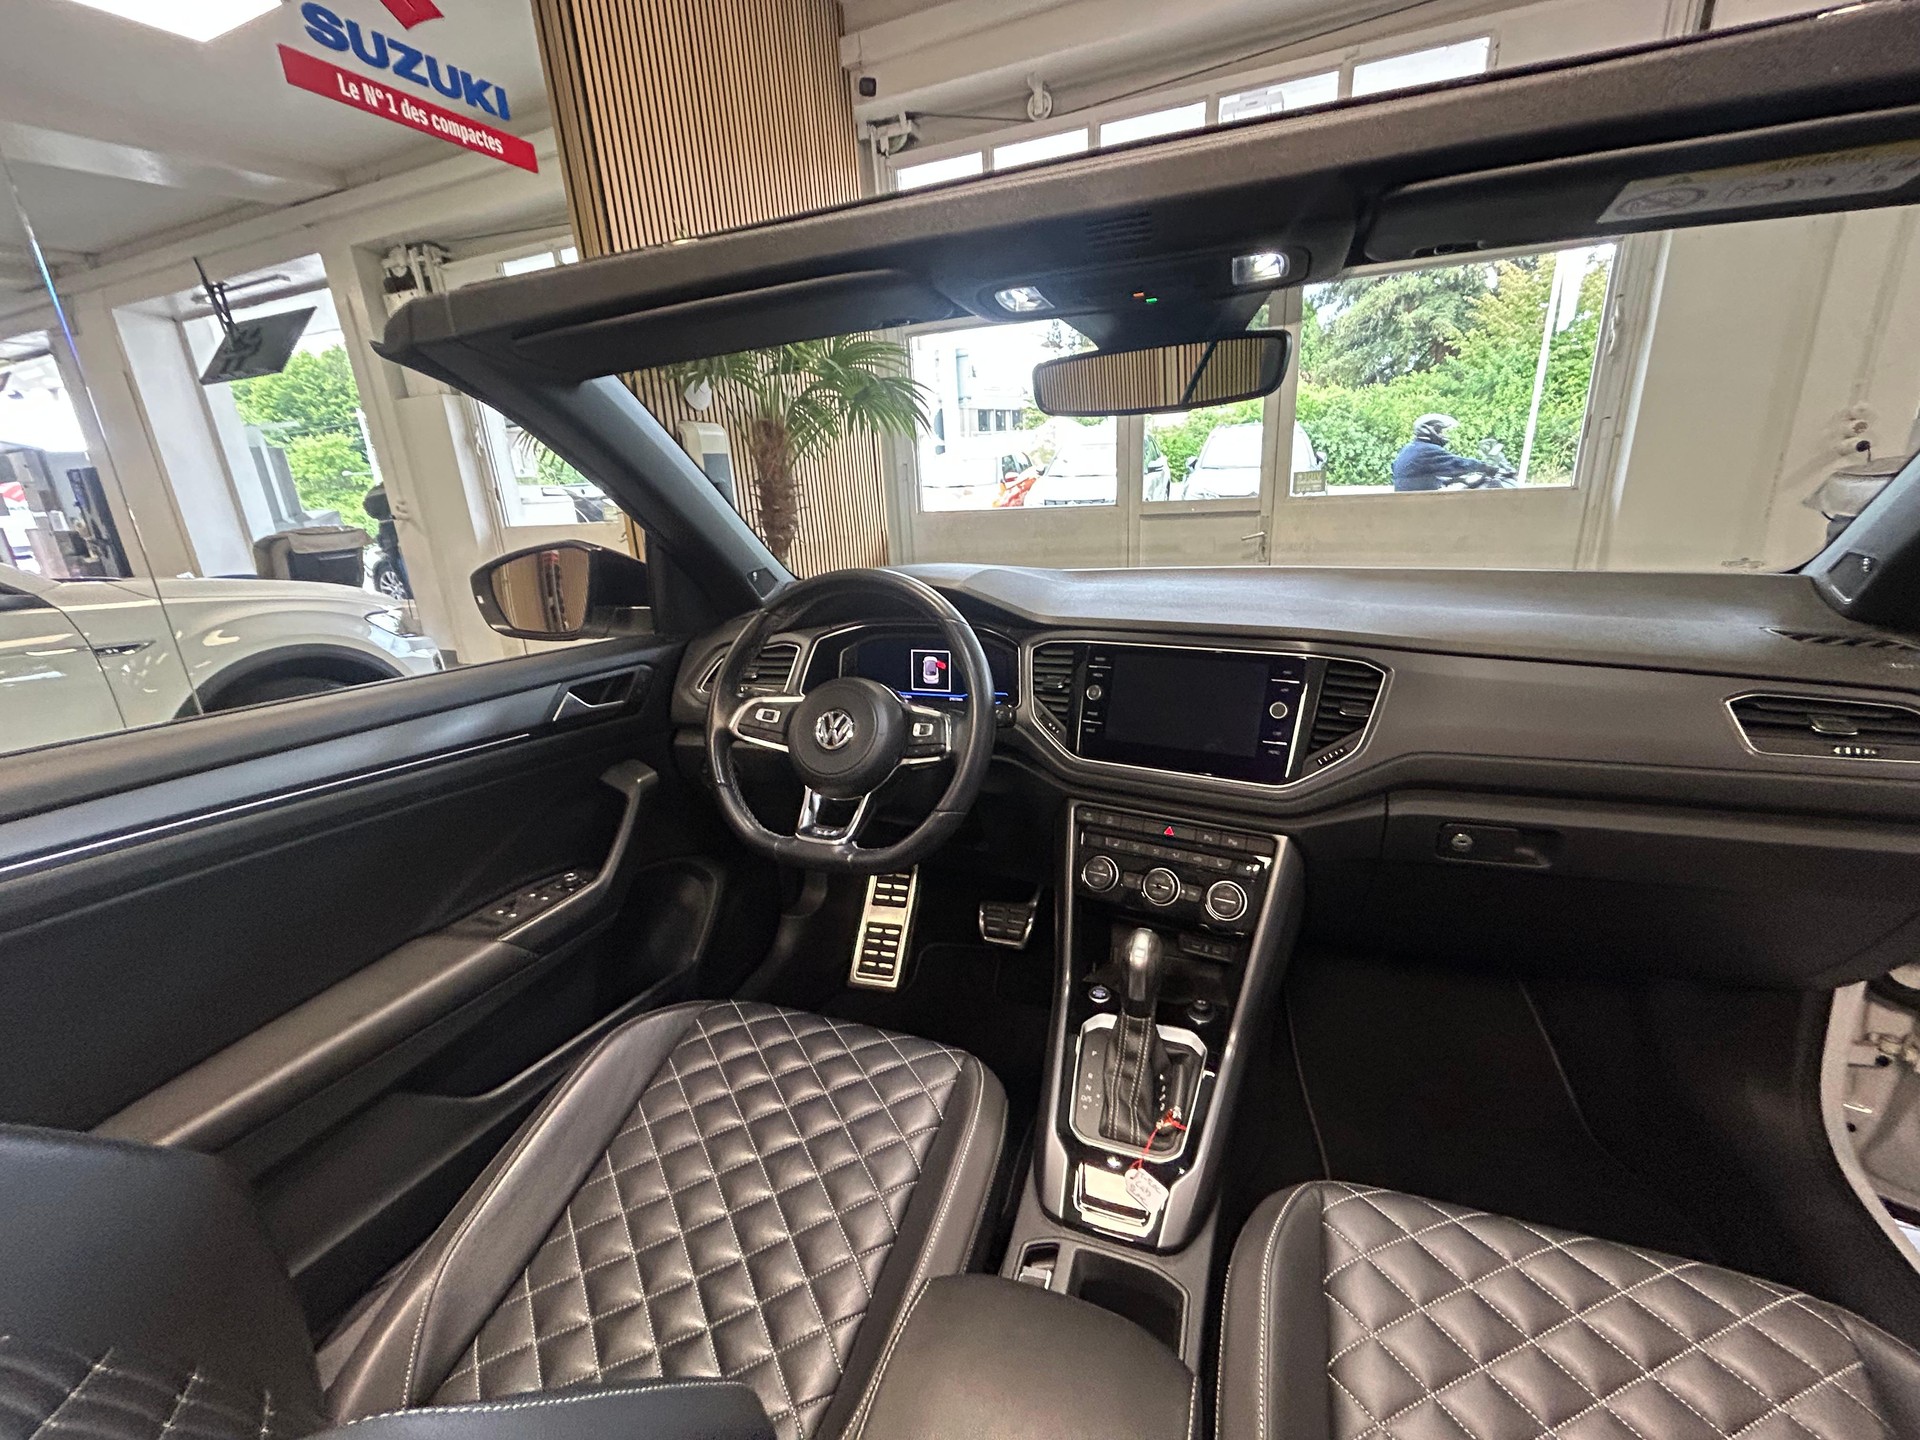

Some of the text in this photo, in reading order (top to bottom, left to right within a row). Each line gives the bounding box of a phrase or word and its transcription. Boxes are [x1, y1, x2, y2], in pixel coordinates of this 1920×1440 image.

[301, 2, 511, 121] SUZUKI
[336, 72, 361, 100] Le
[400, 98, 429, 127] des
[431, 113, 504, 155] compactes
